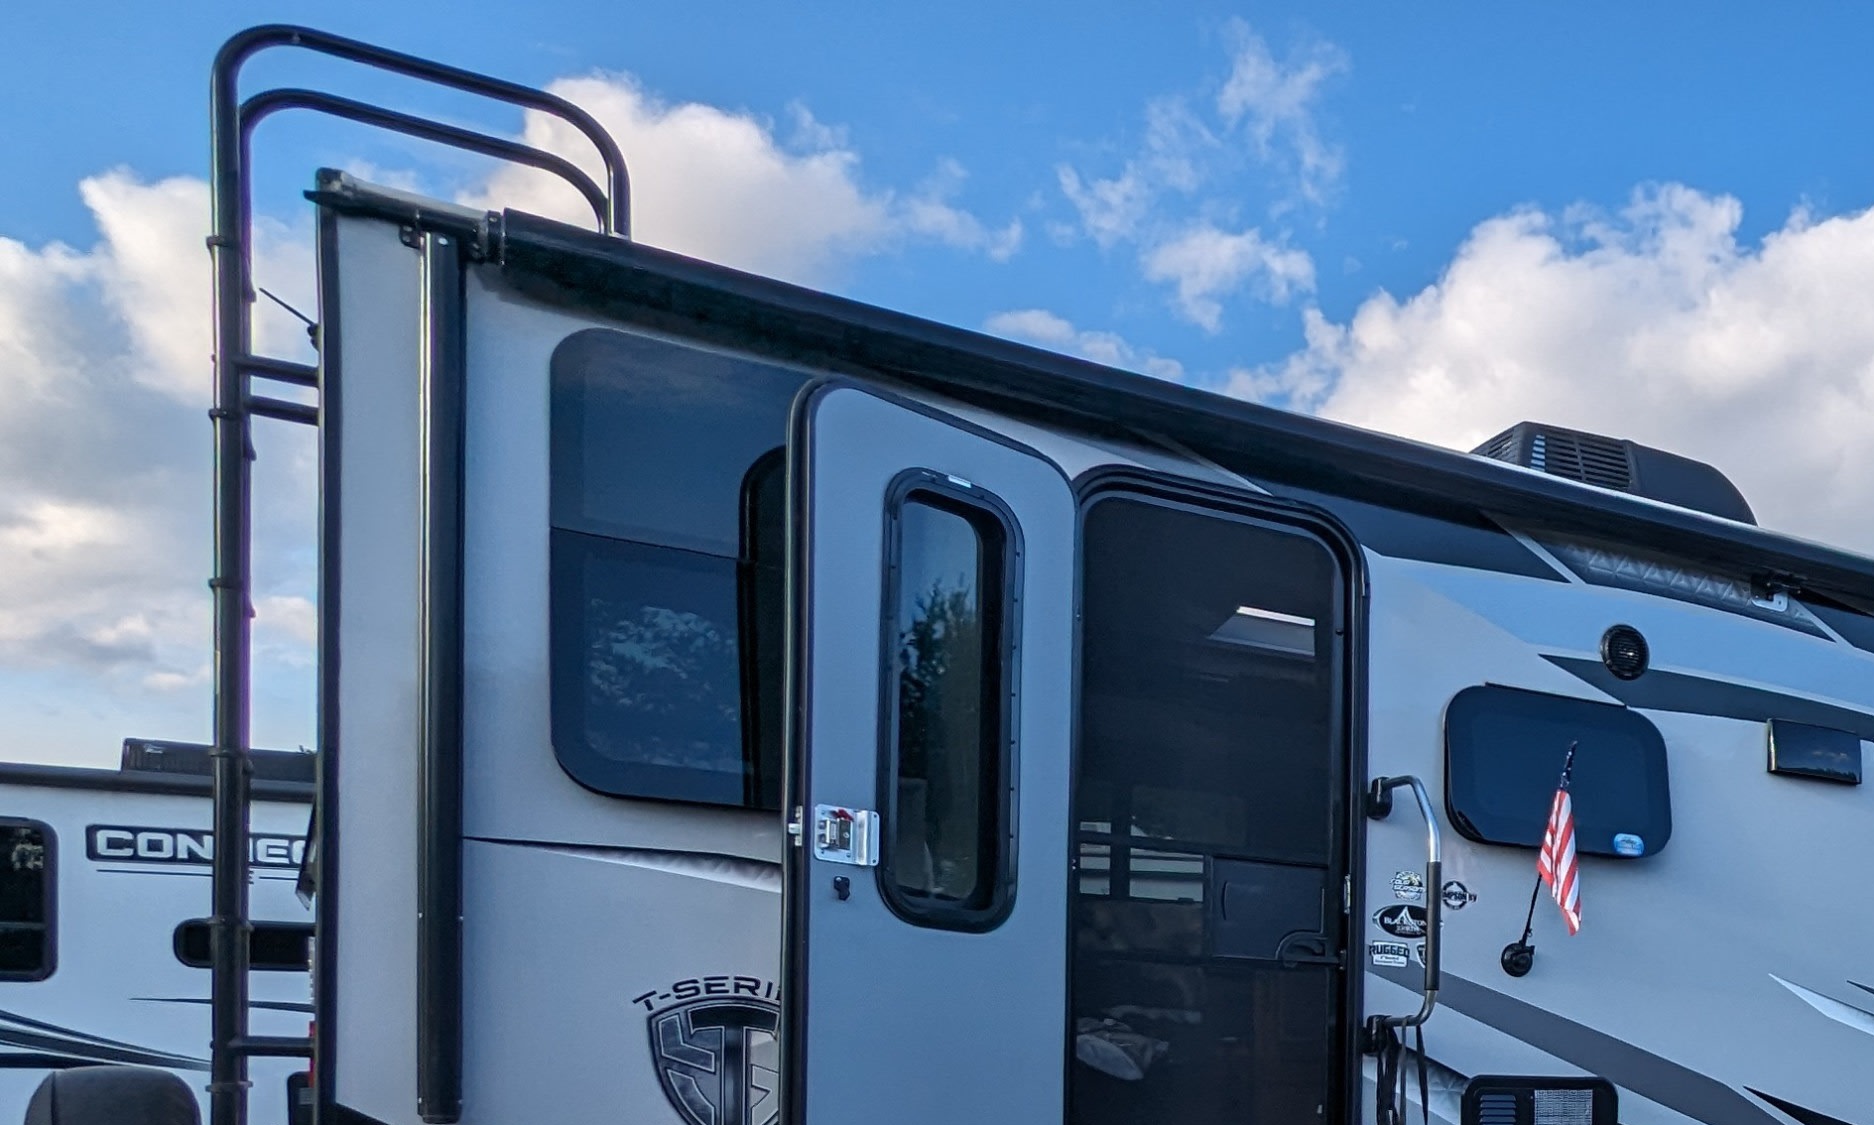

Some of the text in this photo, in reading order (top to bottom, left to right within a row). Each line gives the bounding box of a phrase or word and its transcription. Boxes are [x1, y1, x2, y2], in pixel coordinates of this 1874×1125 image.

[96, 829, 306, 865] CONE
[1369, 944, 1410, 958] RUGGED
[632, 975, 782, 1011] T-SERI
